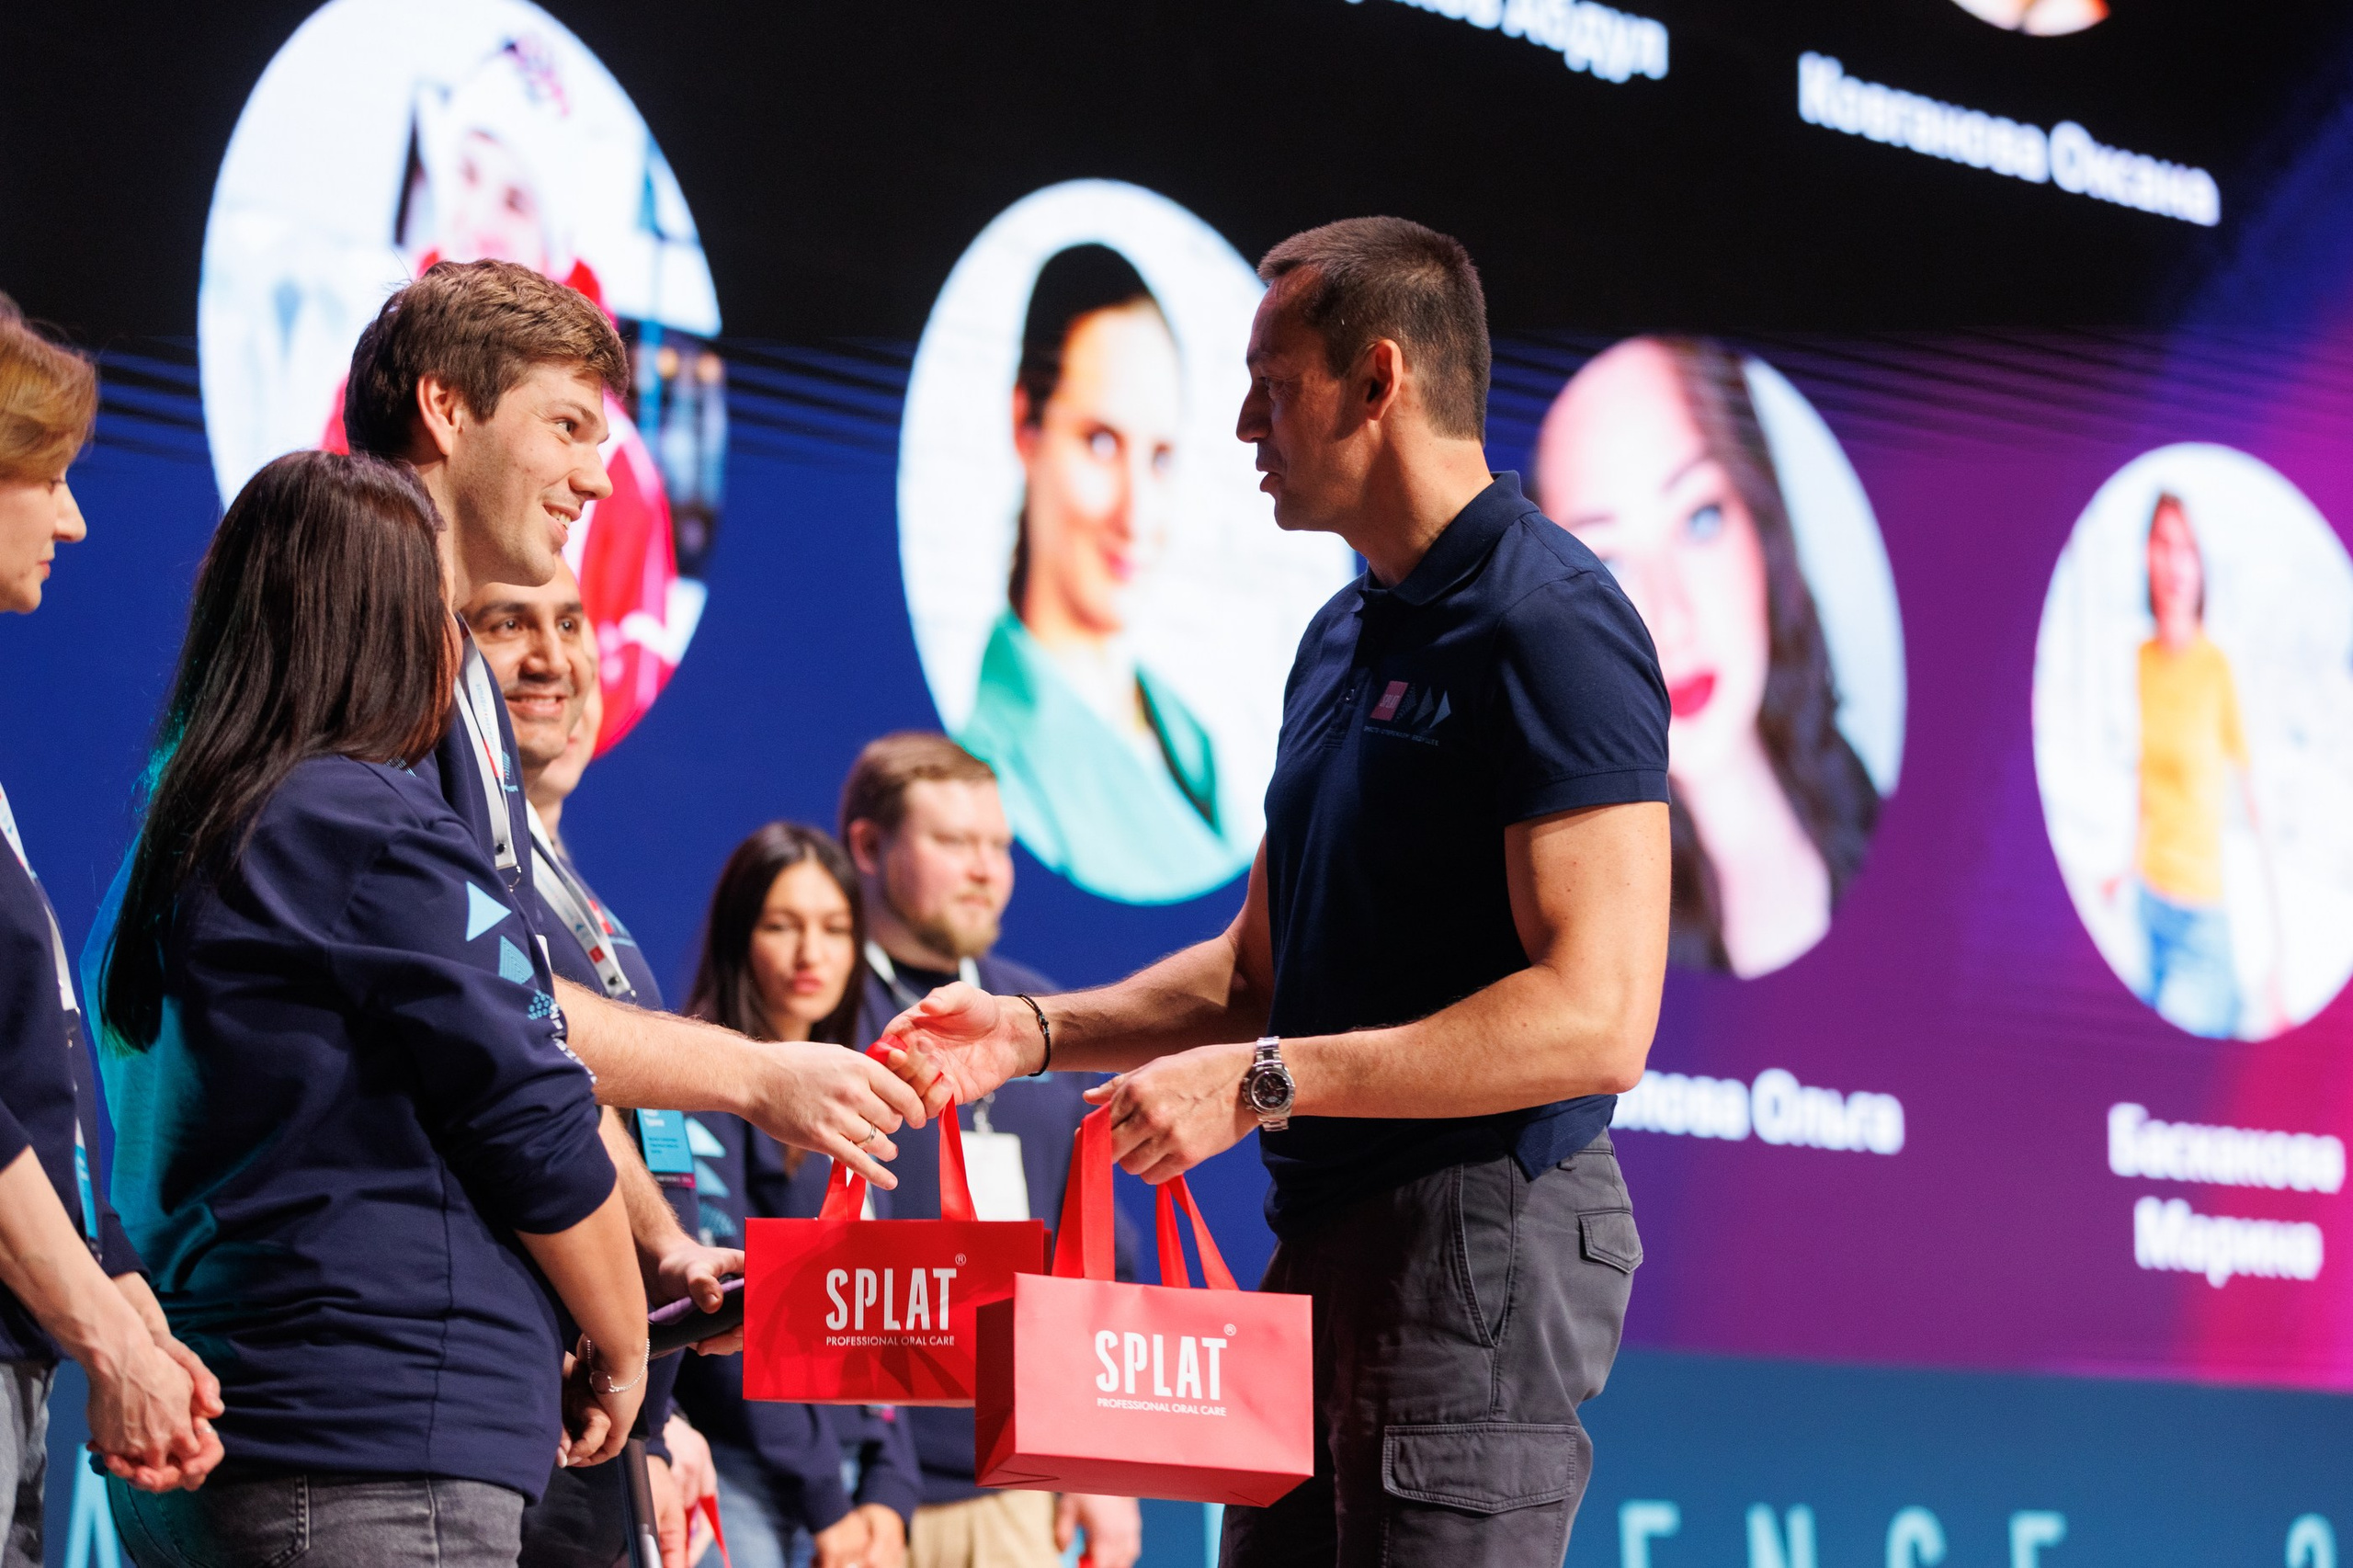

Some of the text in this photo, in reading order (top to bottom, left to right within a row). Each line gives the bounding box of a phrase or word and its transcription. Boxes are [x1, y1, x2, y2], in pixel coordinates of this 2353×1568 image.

[2049, 120, 2221, 226] Оксана
[1752, 1068, 1905, 1155] Ольга
[2134, 1196, 2324, 1289] Марина
[826, 1268, 957, 1330] SPLAT
[826, 1335, 954, 1346] PROFESSIONAL ORAL CARE
[1095, 1330, 1227, 1401] SPLAT
[1097, 1397, 1227, 1416] PROFESSIONAL ORAL CARE
